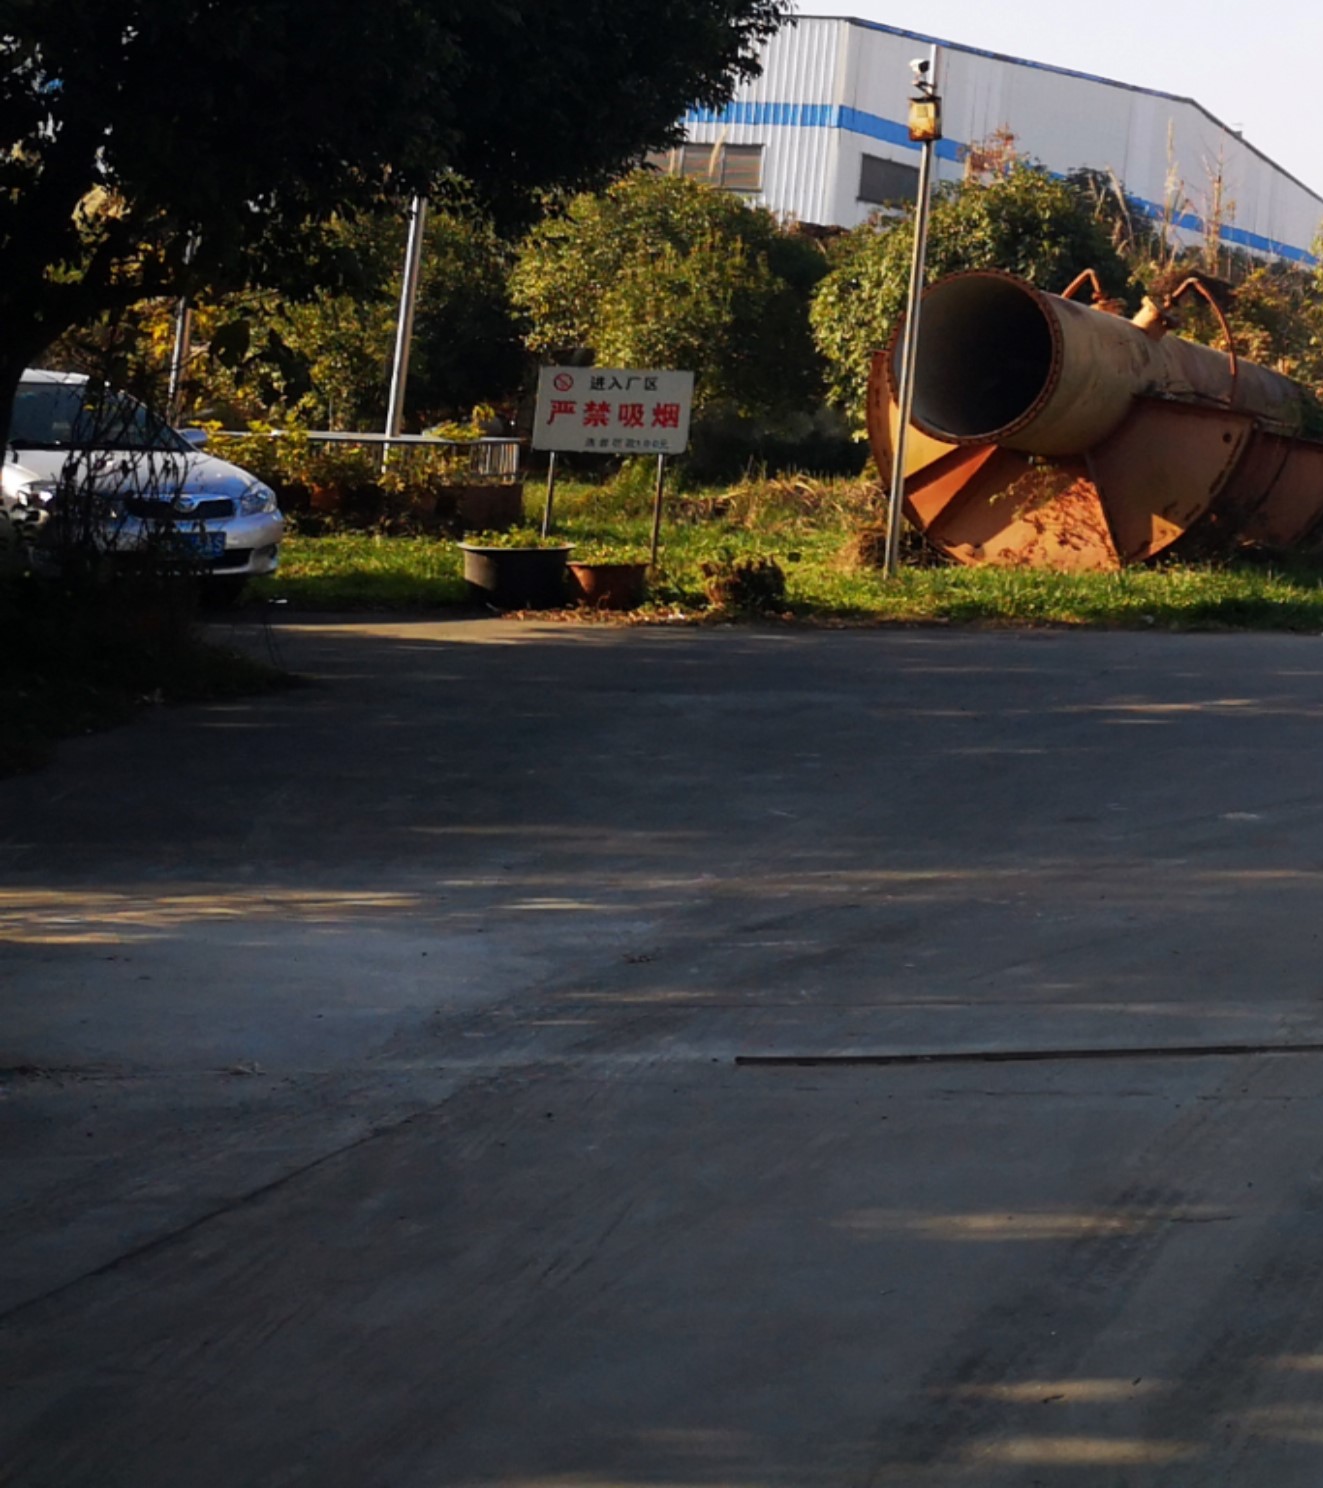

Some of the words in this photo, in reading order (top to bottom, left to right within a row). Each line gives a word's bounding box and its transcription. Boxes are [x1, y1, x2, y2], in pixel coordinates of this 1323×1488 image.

[590, 376, 659, 392] 进入厂区
[547, 400, 681, 429] 严禁吸烟
